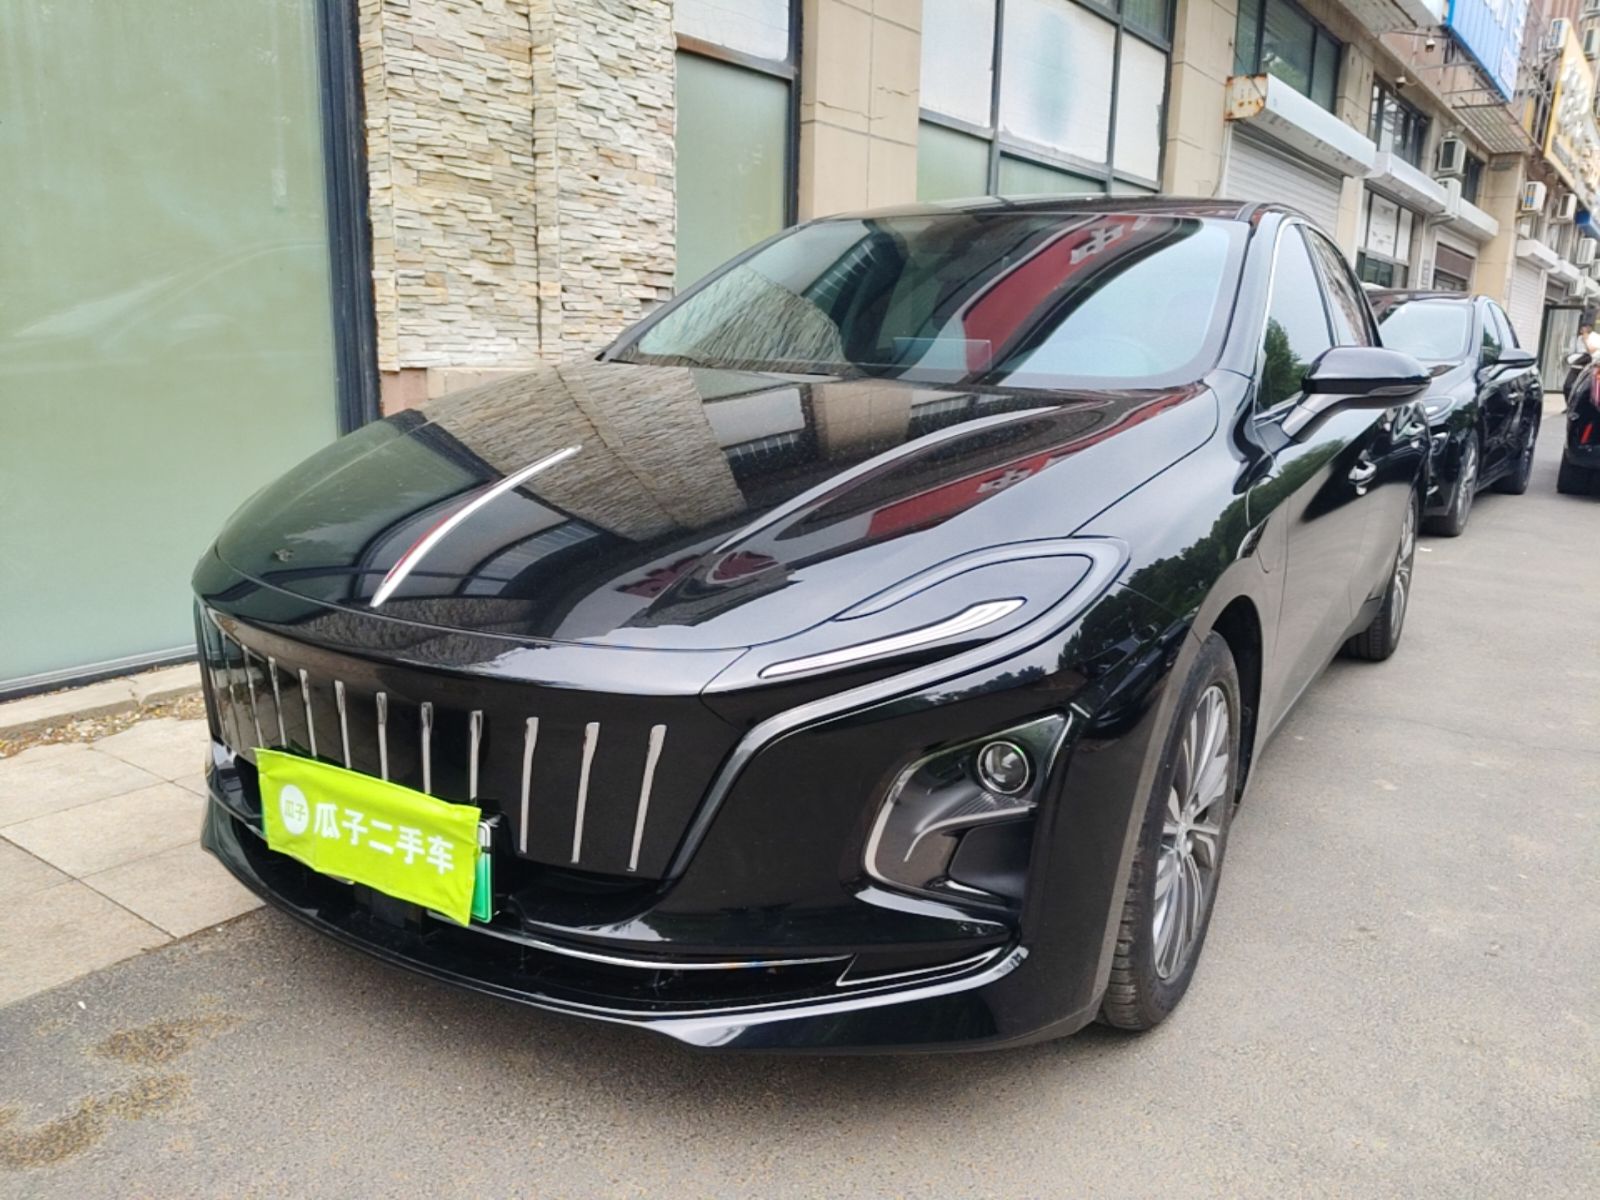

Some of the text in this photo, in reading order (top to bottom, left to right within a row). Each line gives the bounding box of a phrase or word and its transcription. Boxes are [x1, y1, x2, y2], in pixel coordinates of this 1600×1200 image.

[313, 802, 455, 876] 瓜子二手车
